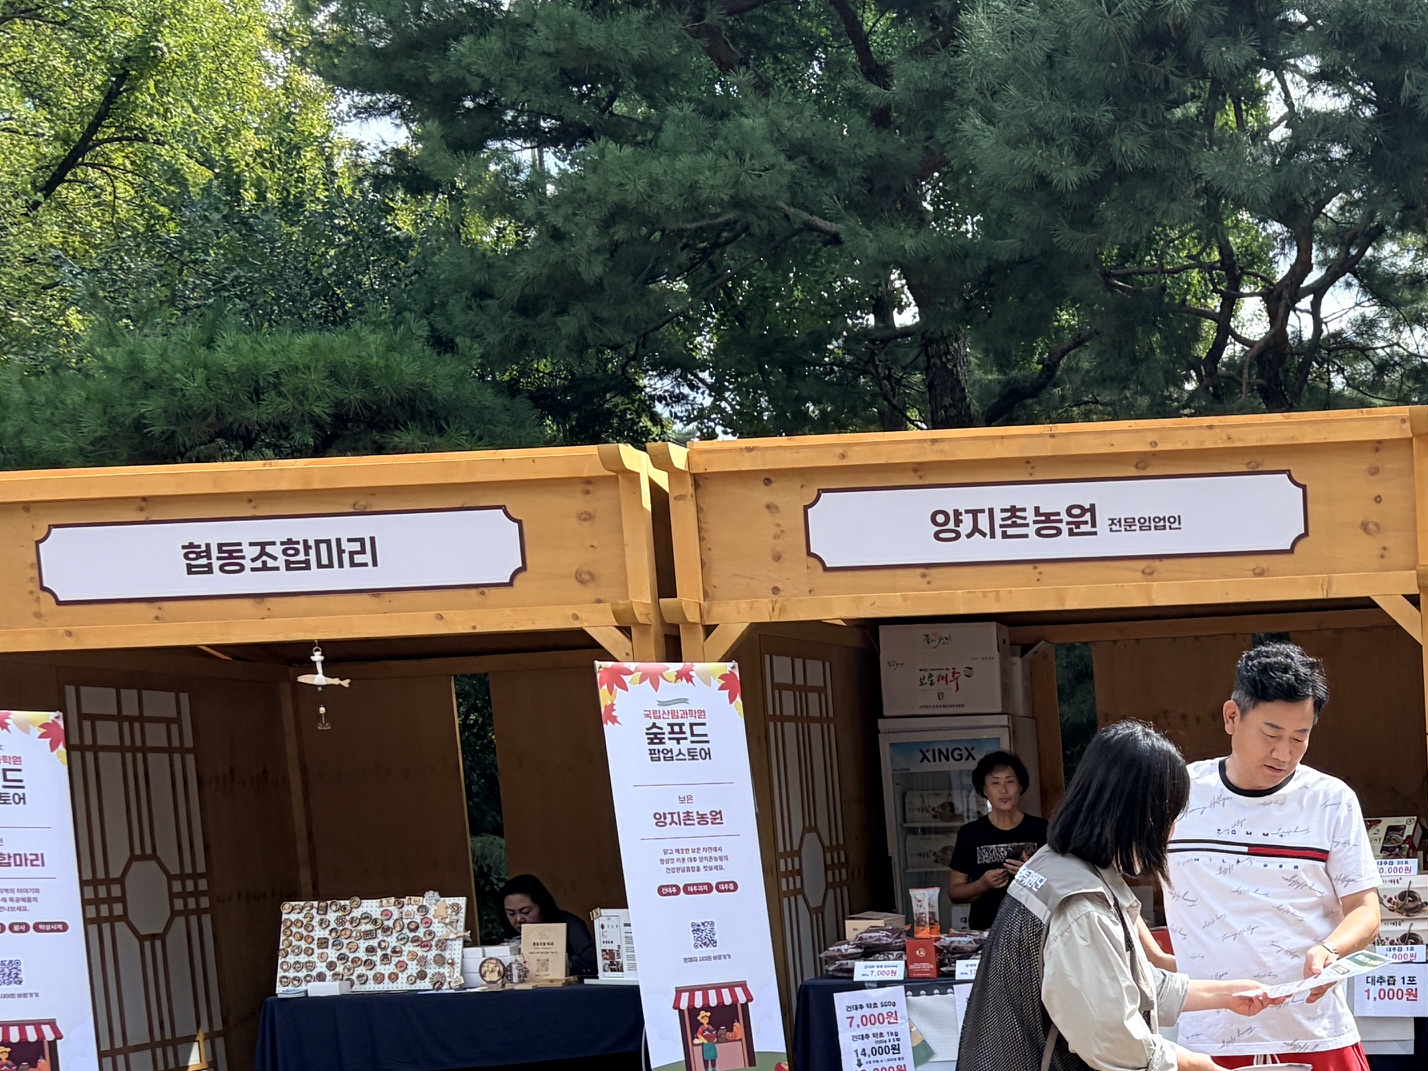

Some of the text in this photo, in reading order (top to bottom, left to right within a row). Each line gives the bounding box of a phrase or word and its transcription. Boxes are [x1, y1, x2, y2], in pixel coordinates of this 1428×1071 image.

[930, 503, 1181, 542] 양지촌농원 전문임업인
[181, 536, 378, 576] 협동조합마리
[643, 710, 706, 720] 국립산림과학원
[645, 722, 710, 745] 숲푸드
[0, 755, 22, 765] 학원
[648, 748, 711, 762] 팝업스토어
[919, 746, 976, 763] XINGX
[678, 795, 693, 804] 보은
[653, 810, 724, 827] 양지촌농원
[1366, 975, 1397, 986] 대추즙
[1365, 988, 1418, 1001] 1,000원
[846, 1010, 899, 1029] 7,000원
[854, 1043, 901, 1058] 14,000원
